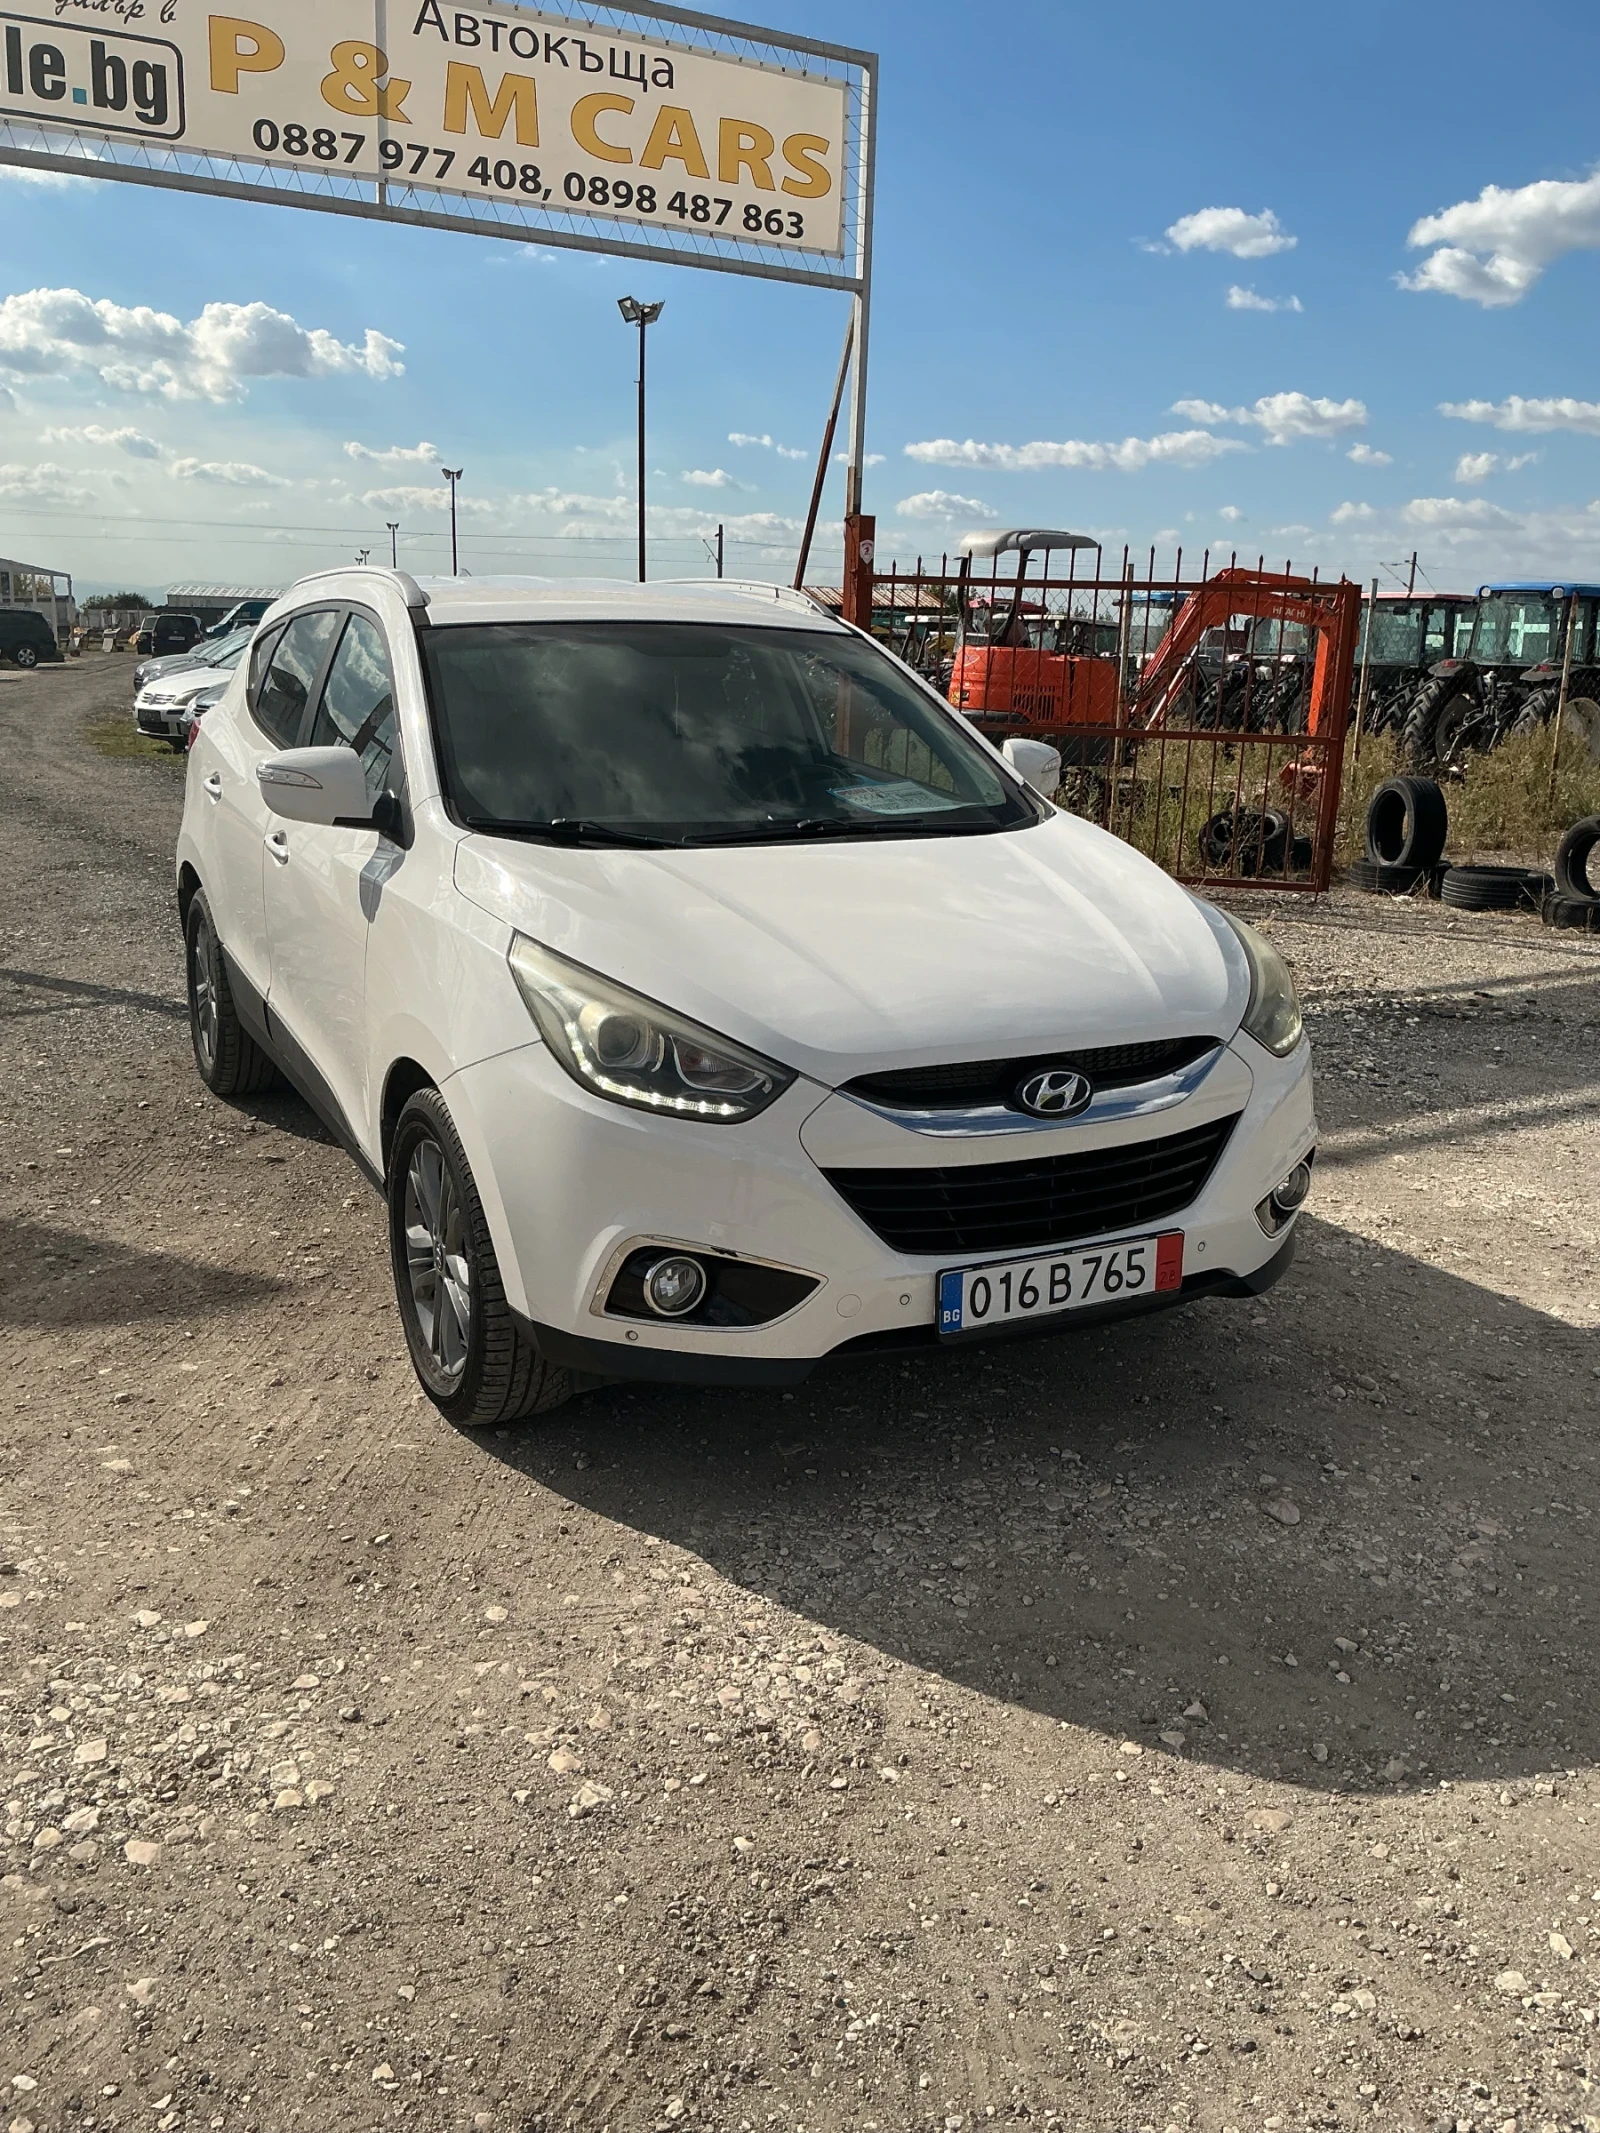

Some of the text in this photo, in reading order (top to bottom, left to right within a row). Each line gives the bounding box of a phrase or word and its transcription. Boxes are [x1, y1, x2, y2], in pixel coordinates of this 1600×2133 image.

[412, 0, 676, 93] Автокъща
[208, 14, 832, 199] P & M CARS
[252, 118, 805, 239] 0887 977 408, 0898 487 863
[943, 1308, 961, 1324] BG
[969, 1267, 1039, 1318] 016
[1081, 1247, 1146, 1299] 765
